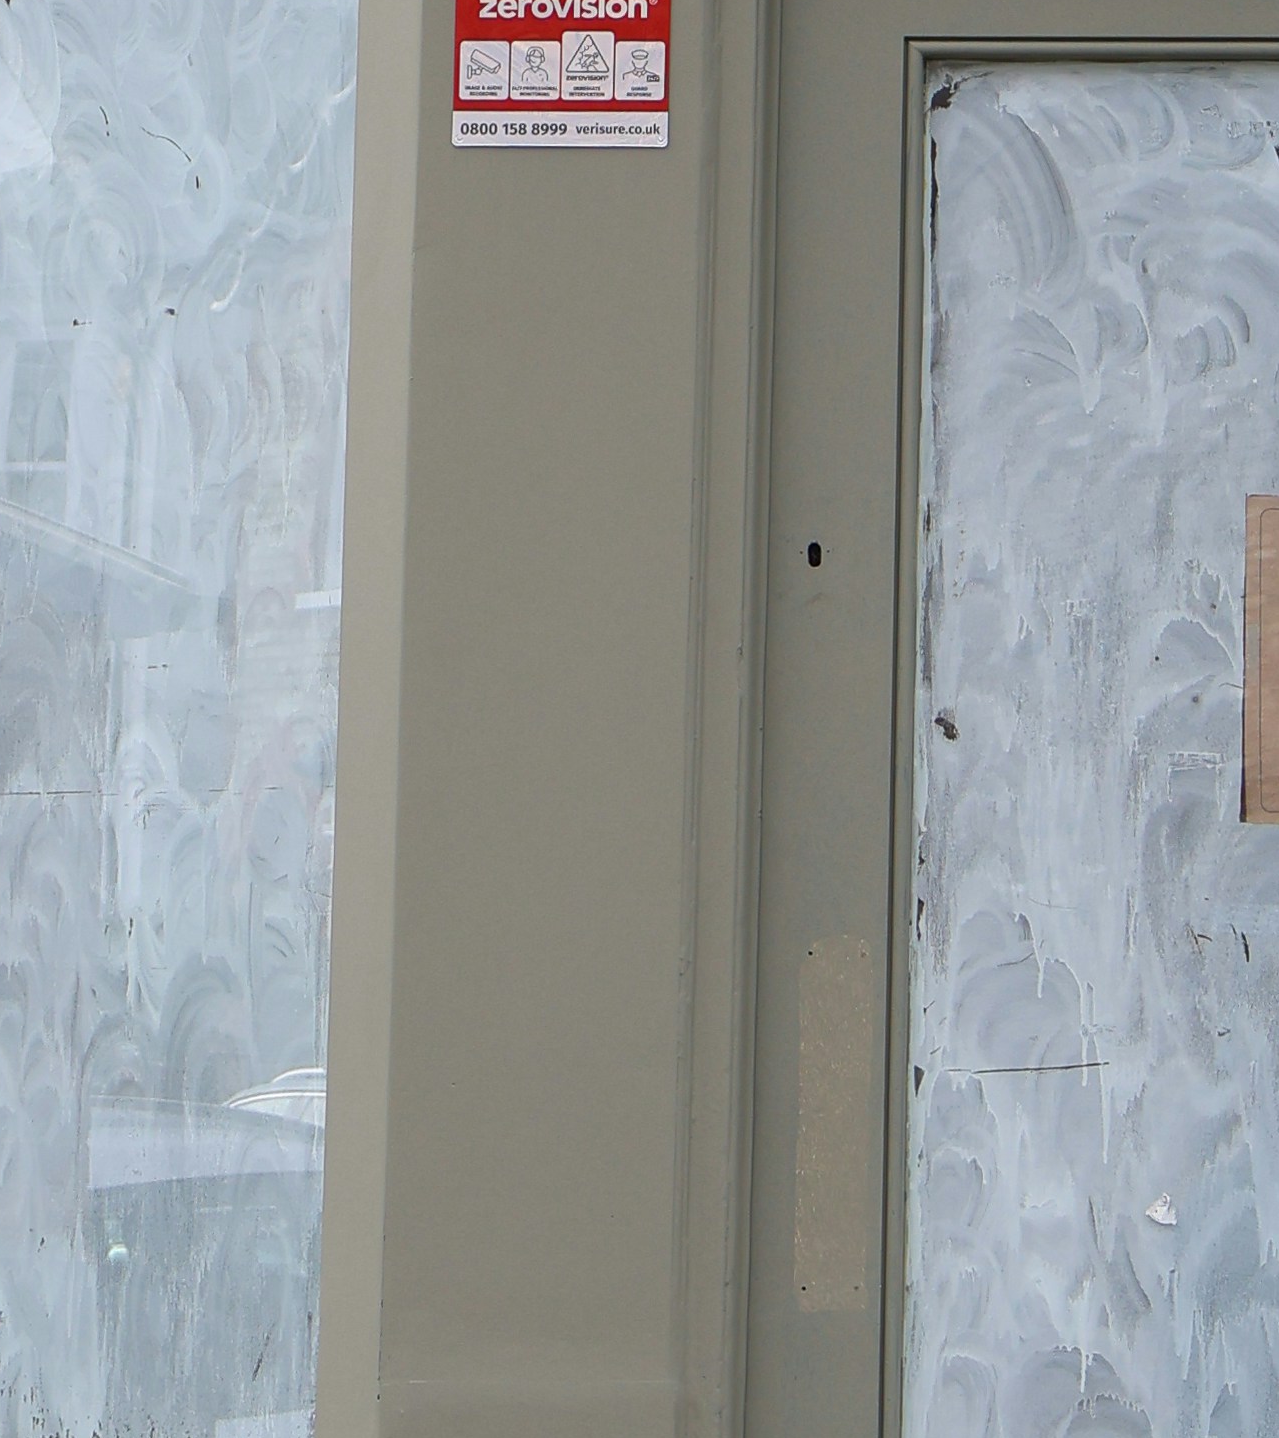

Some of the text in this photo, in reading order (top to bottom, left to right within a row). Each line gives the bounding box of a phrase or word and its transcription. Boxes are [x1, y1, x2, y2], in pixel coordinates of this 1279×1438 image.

[460, 122, 661, 135] 0800 158 8999 verisure.co.uk
